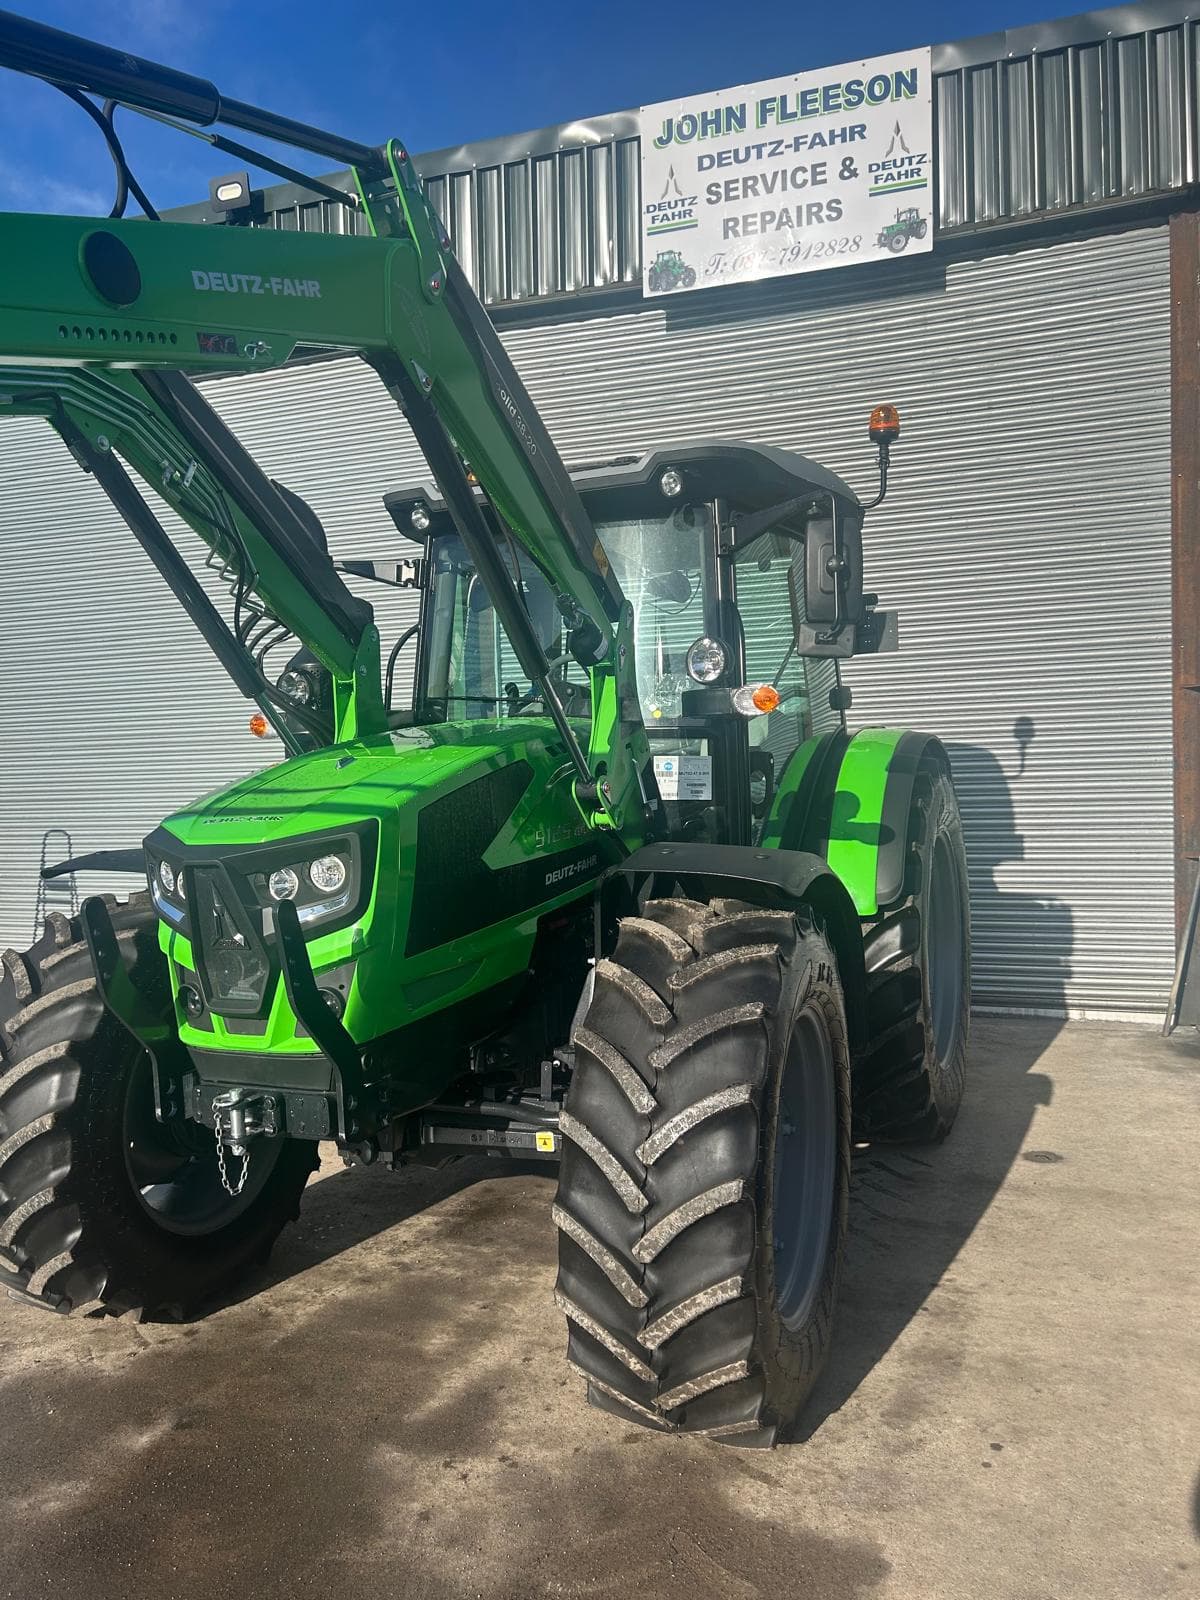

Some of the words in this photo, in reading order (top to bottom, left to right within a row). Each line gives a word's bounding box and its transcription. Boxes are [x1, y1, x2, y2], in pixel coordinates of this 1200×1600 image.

[653, 103, 747, 149] JOHN
[756, 67, 918, 128] FLEESON
[697, 123, 867, 172] DEUTZ-FAHR
[868, 153, 928, 174] DEUTZ
[874, 167, 922, 185] FAHR
[706, 162, 828, 205] SERVICE
[838, 156, 859, 181] &
[646, 195, 699, 214] DEUTZ
[651, 208, 694, 225] FAHR
[723, 198, 844, 240] REPAIRS
[191, 270, 322, 298] DEUTZ-FAHR
[545, 854, 598, 886] DEUTZ-FAHR
